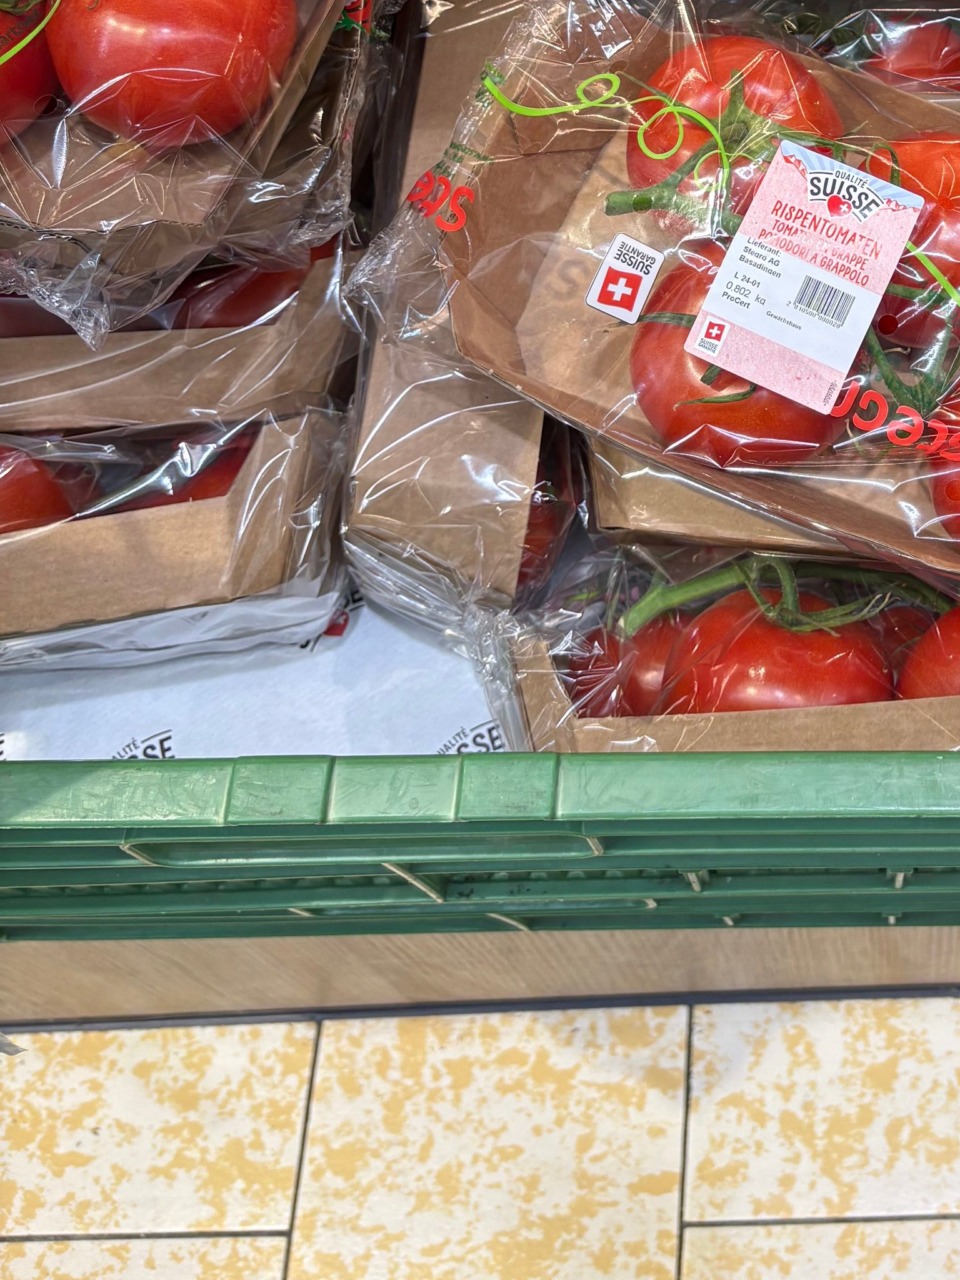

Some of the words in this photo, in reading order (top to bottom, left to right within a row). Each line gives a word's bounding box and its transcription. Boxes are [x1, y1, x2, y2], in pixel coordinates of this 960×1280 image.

[835, 170, 869, 188] QUALITÉ
[809, 176, 880, 219] SUISSE
[771, 200, 882, 260] RISPENTOMATEN
[619, 240, 657, 266] GARANTIE
[747, 237, 782, 258] Lieferant:
[614, 248, 653, 276] SUISSE
[767, 257, 781, 267] AG
[809, 253, 818, 263] A
[819, 256, 870, 287] GRAPPOLO
[725, 281, 751, 299] 0.802
[740, 274, 761, 289] 24-01
[722, 291, 751, 310] ProCert
[436, 726, 470, 754] UALITÉ
